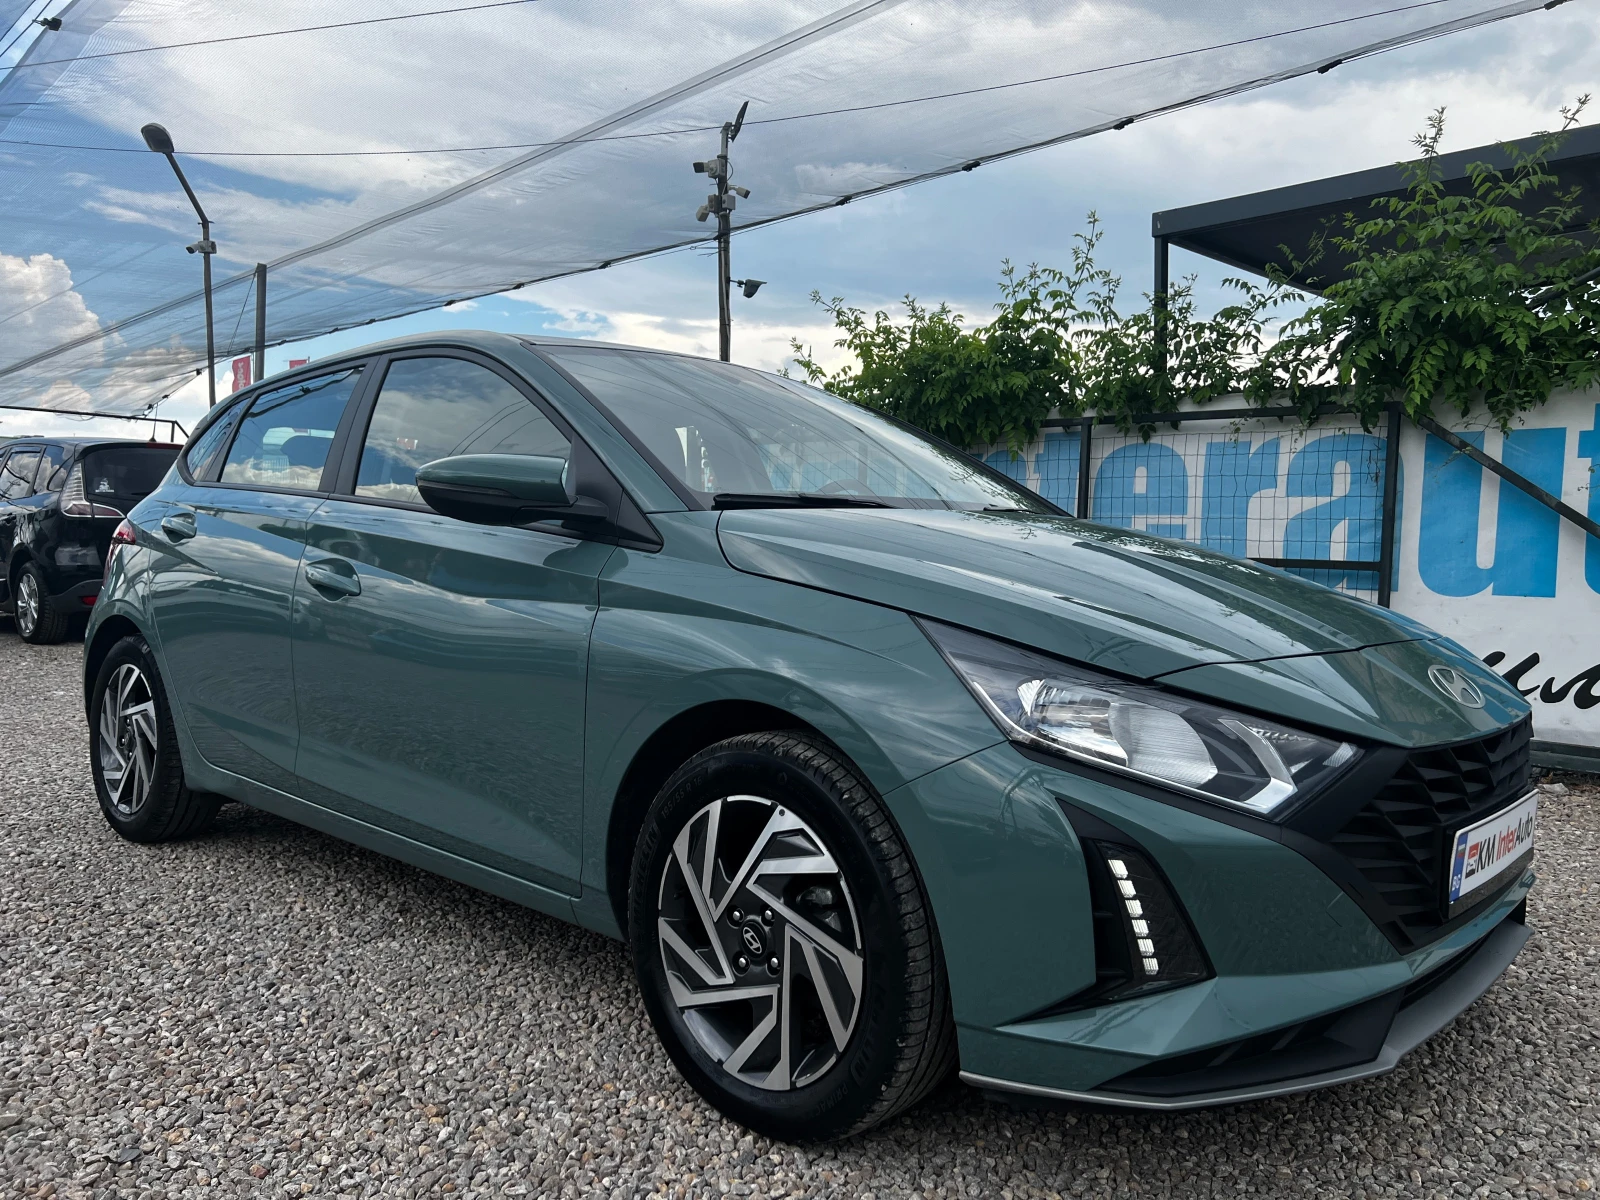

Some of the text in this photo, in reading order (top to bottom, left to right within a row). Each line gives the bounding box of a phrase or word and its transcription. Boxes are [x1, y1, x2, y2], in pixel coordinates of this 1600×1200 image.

[661, 788, 687, 819] 195/55
[693, 776, 703, 787] 16
[1476, 811, 1533, 873] KM InterAuto
[633, 822, 660, 926] MICHELIN
[814, 1081, 850, 1115] PRIMAC
